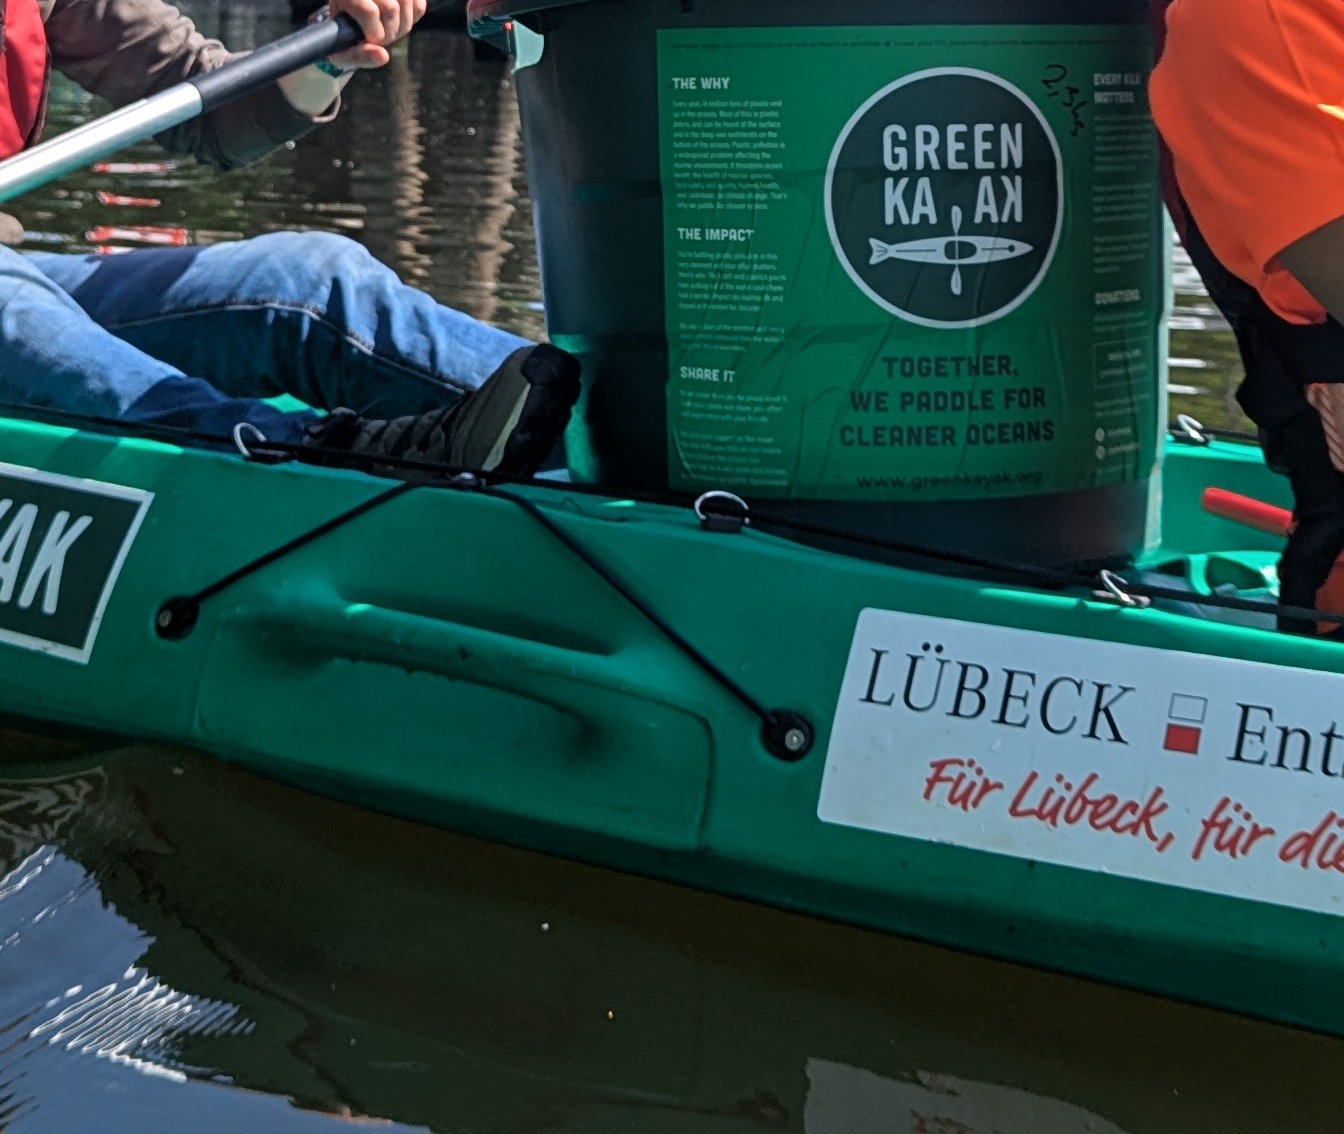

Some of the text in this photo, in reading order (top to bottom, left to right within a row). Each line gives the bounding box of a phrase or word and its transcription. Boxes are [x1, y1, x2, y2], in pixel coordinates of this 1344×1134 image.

[672, 77, 730, 90] THE WHY
[883, 123, 1024, 171] GREEN
[884, 175, 1024, 225] KAAK
[677, 227, 755, 242] THE IMPACT
[680, 366, 736, 383] SHARE IT
[882, 354, 1019, 379] TOGETHER,
[850, 386, 1046, 413] WE PADDLE FOR
[840, 420, 1055, 447] CLEANER OCEANS
[859, 642, 1136, 746] LÜBECK
[923, 757, 1003, 811] Für
[1009, 771, 1176, 852] Lübeck,
[1192, 796, 1275, 861] für
